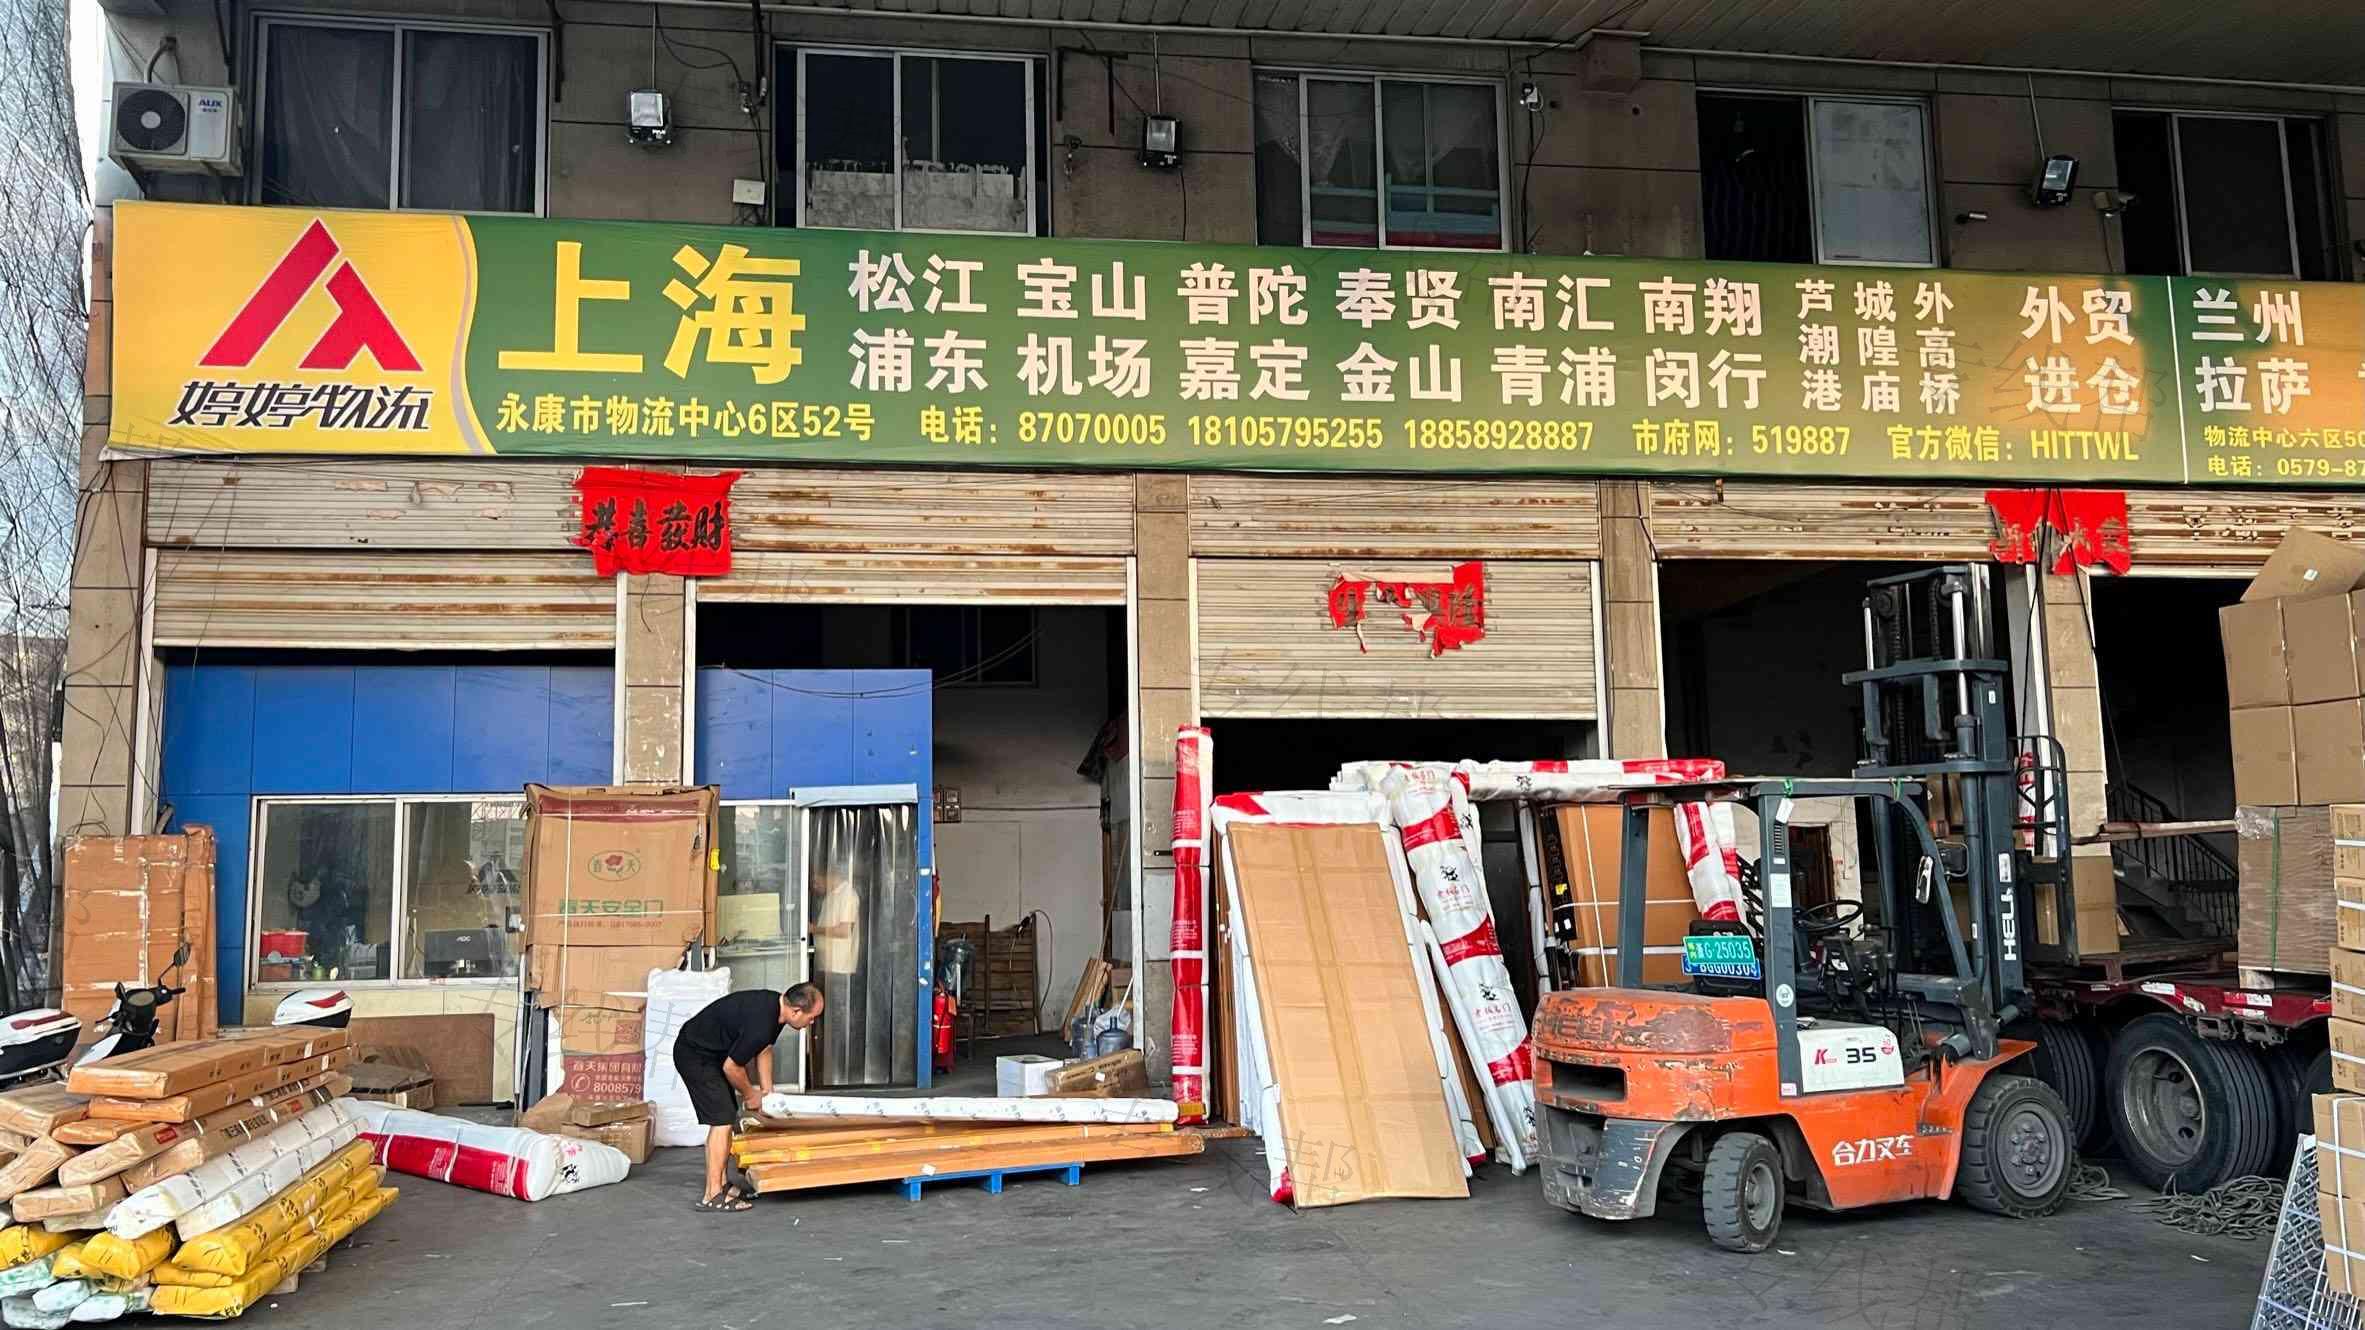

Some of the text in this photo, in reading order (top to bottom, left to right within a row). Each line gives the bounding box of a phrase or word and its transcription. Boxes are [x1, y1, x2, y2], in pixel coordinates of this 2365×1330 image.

[499, 242, 805, 384] 上海
[848, 249, 1762, 336] 松江 宝山 普陀 奉贤 南汇 南翔
[2021, 286, 2134, 345] 外贸
[2192, 288, 2304, 346] 兰州
[848, 328, 1767, 410] 浦东 机场 嘉定 金山 青浦 闵行
[1796, 280, 1843, 412] 芦潮港
[1854, 281, 1901, 413] 城隍庙
[1913, 283, 1960, 414] 外高桥
[169, 381, 433, 431] 婷婷物流
[2025, 357, 2140, 414] 进仓
[2195, 357, 2311, 414] 拉萨
[496, 393, 876, 440] 永康市物流中心6区52号
[1018, 413, 1167, 446] 87070005
[1188, 415, 1384, 449] 18105795255
[1403, 419, 1594, 451] 18858928887
[1752, 428, 1850, 457] 519887
[2030, 430, 2140, 462] HITTWL
[1845, 1047, 1877, 1064] 35
[1831, 1134, 1915, 1167] 合力叉车
